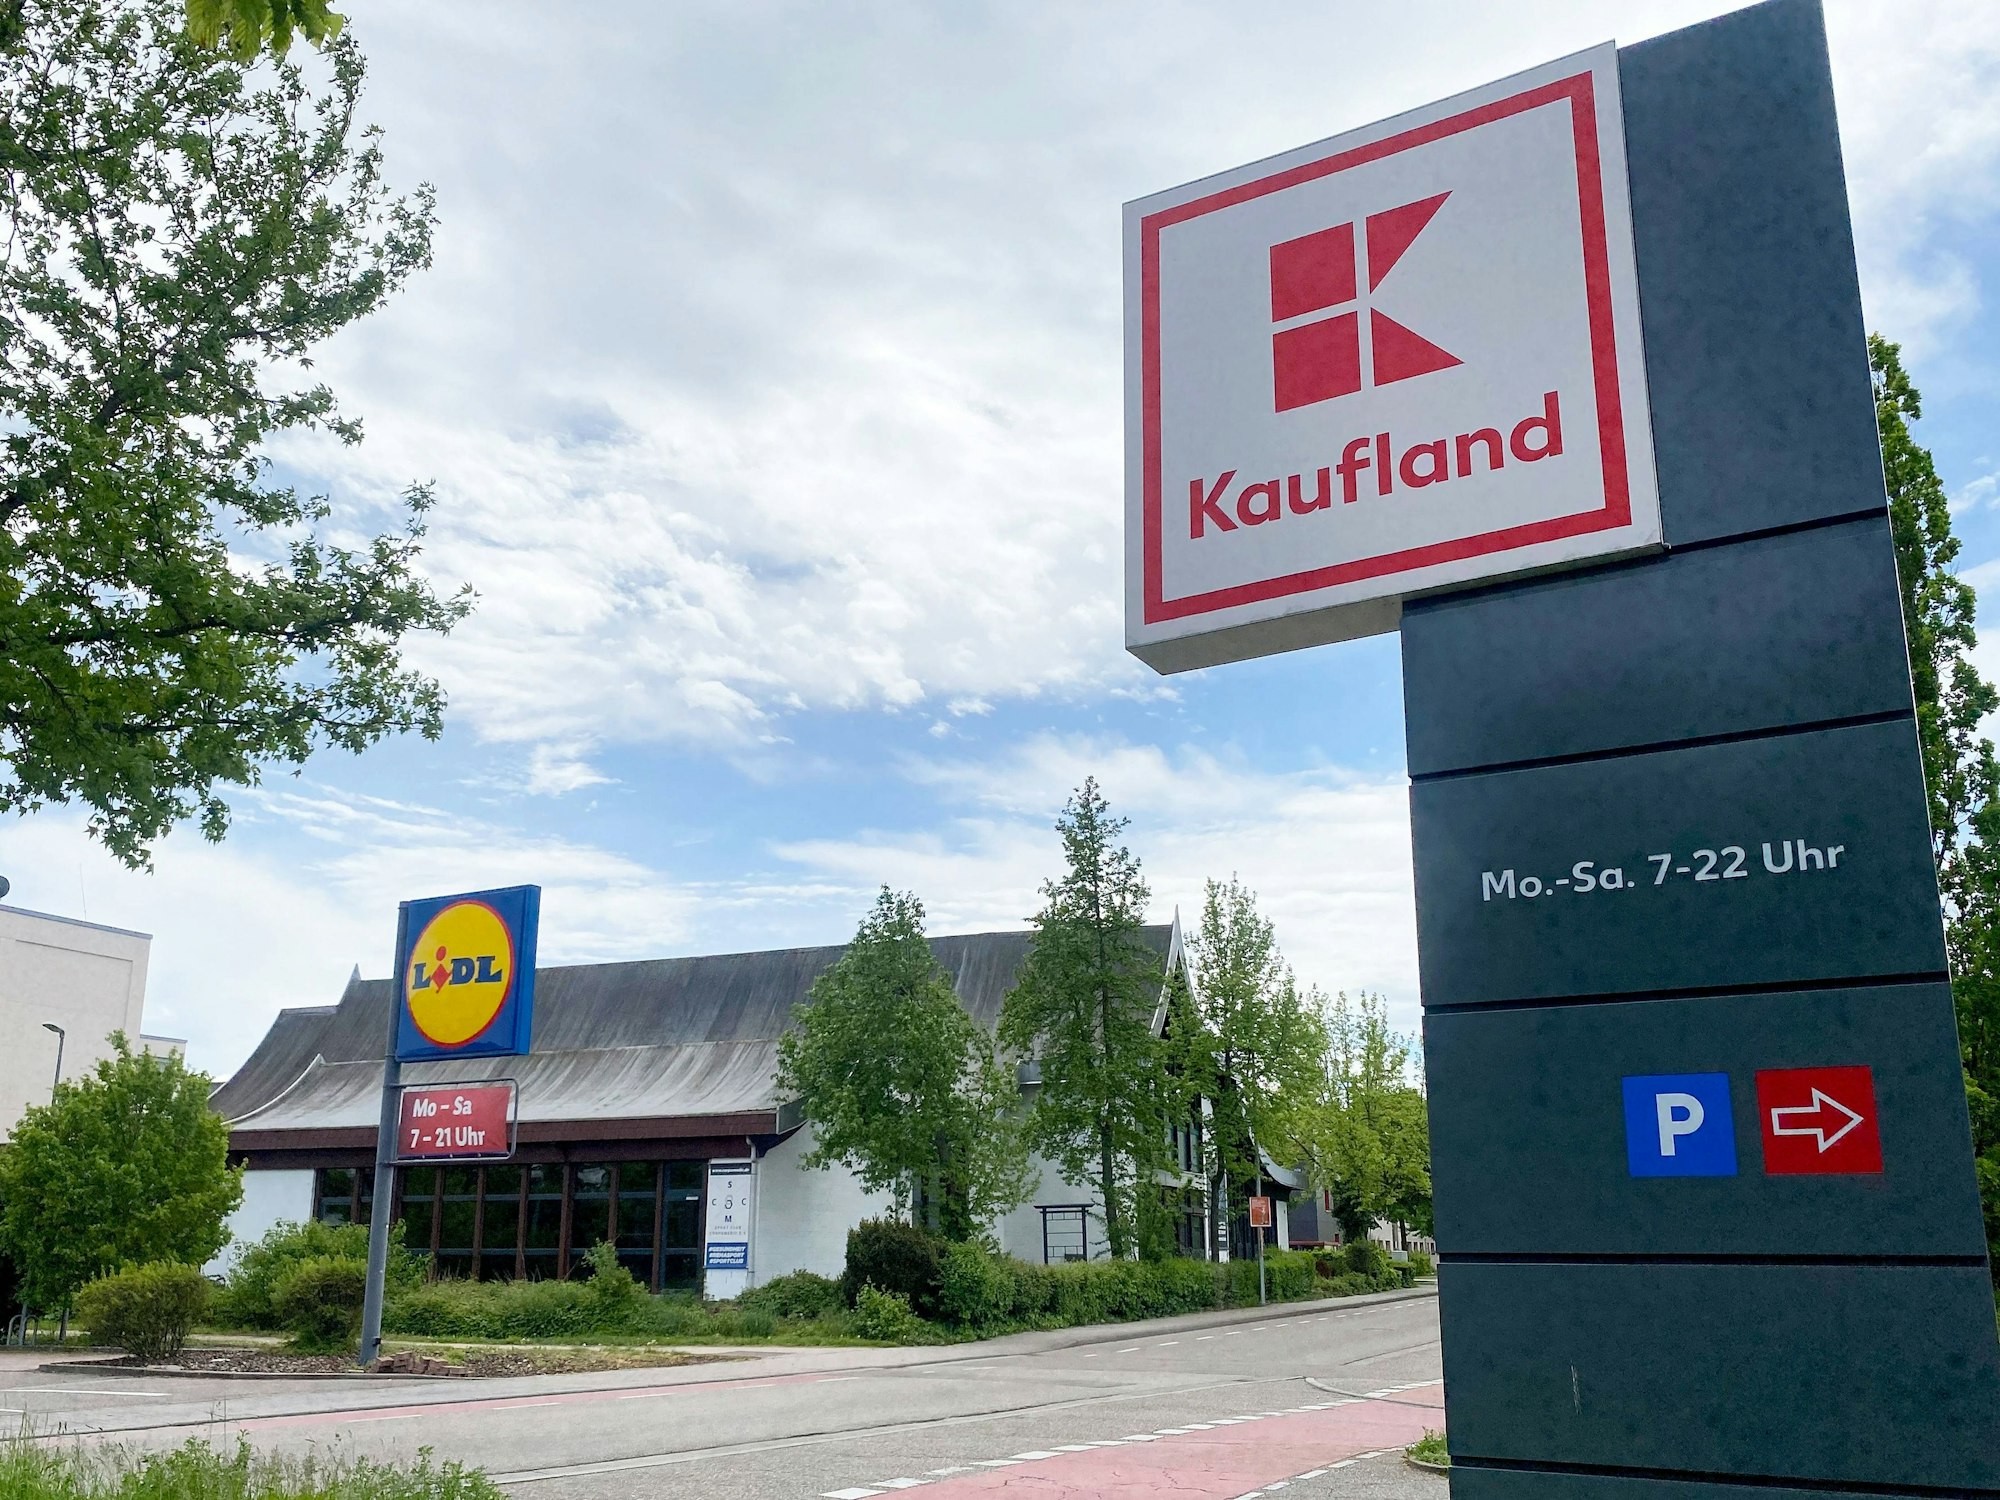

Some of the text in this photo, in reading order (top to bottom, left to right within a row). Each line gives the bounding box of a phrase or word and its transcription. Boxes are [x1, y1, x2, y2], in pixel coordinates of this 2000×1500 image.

[1189, 390, 1563, 539] Kaufland
[1481, 839, 1845, 901] Mo.-Sa. 7-22 Uhr
[412, 1098, 437, 1117] Mo
[452, 1095, 472, 1115] Sa
[1655, 1092, 1704, 1157] P
[410, 1128, 420, 1148] 7
[435, 1127, 452, 1147] 21
[455, 1125, 485, 1147] Uhr
[727, 1181, 732, 1189] S
[724, 1215, 732, 1223] M
